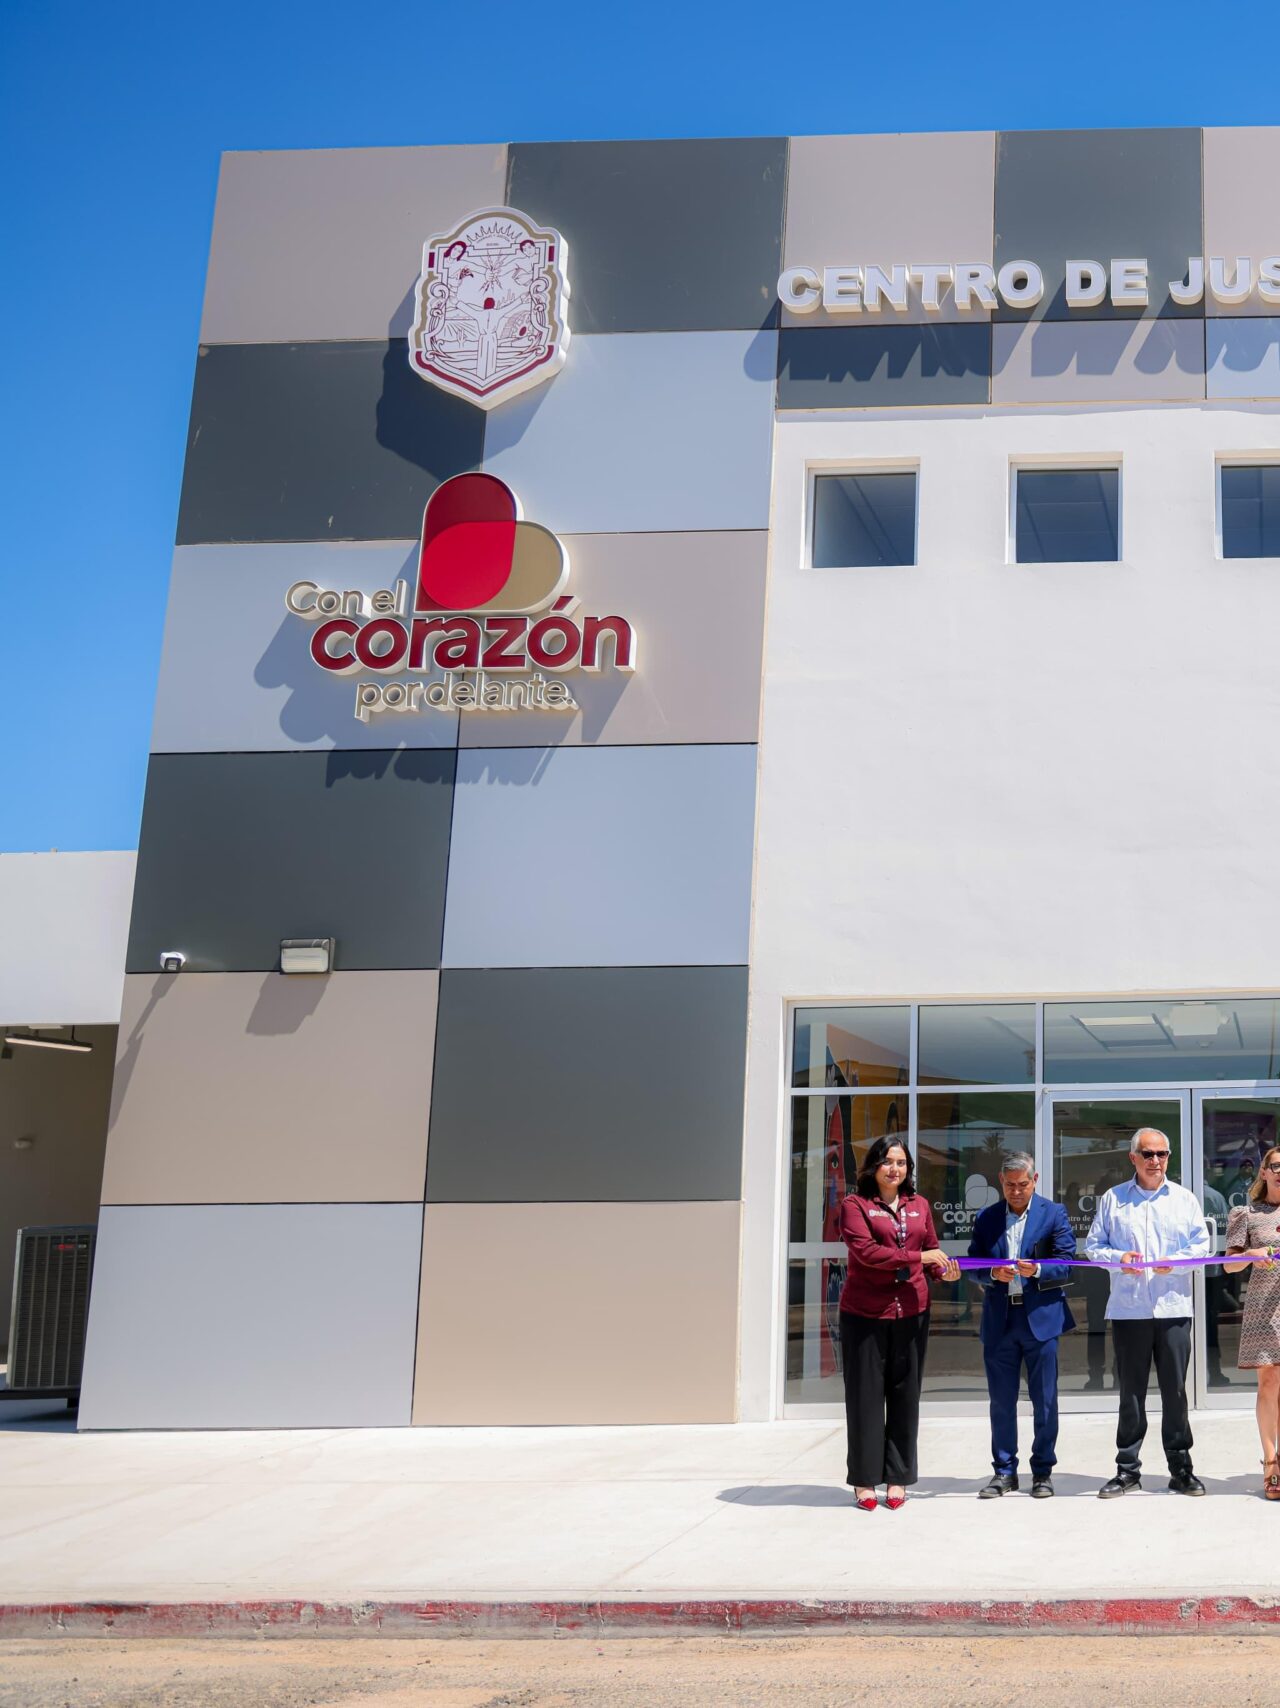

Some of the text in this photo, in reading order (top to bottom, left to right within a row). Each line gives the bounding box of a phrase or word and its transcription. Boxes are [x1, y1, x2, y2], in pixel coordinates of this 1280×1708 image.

[777, 259, 1044, 313] CENTRO
[1065, 257, 1149, 307] DE
[285, 579, 410, 620] Con el
[310, 595, 637, 675] corazón
[933, 1201, 963, 1210] Con el
[955, 1225, 971, 1235] por
